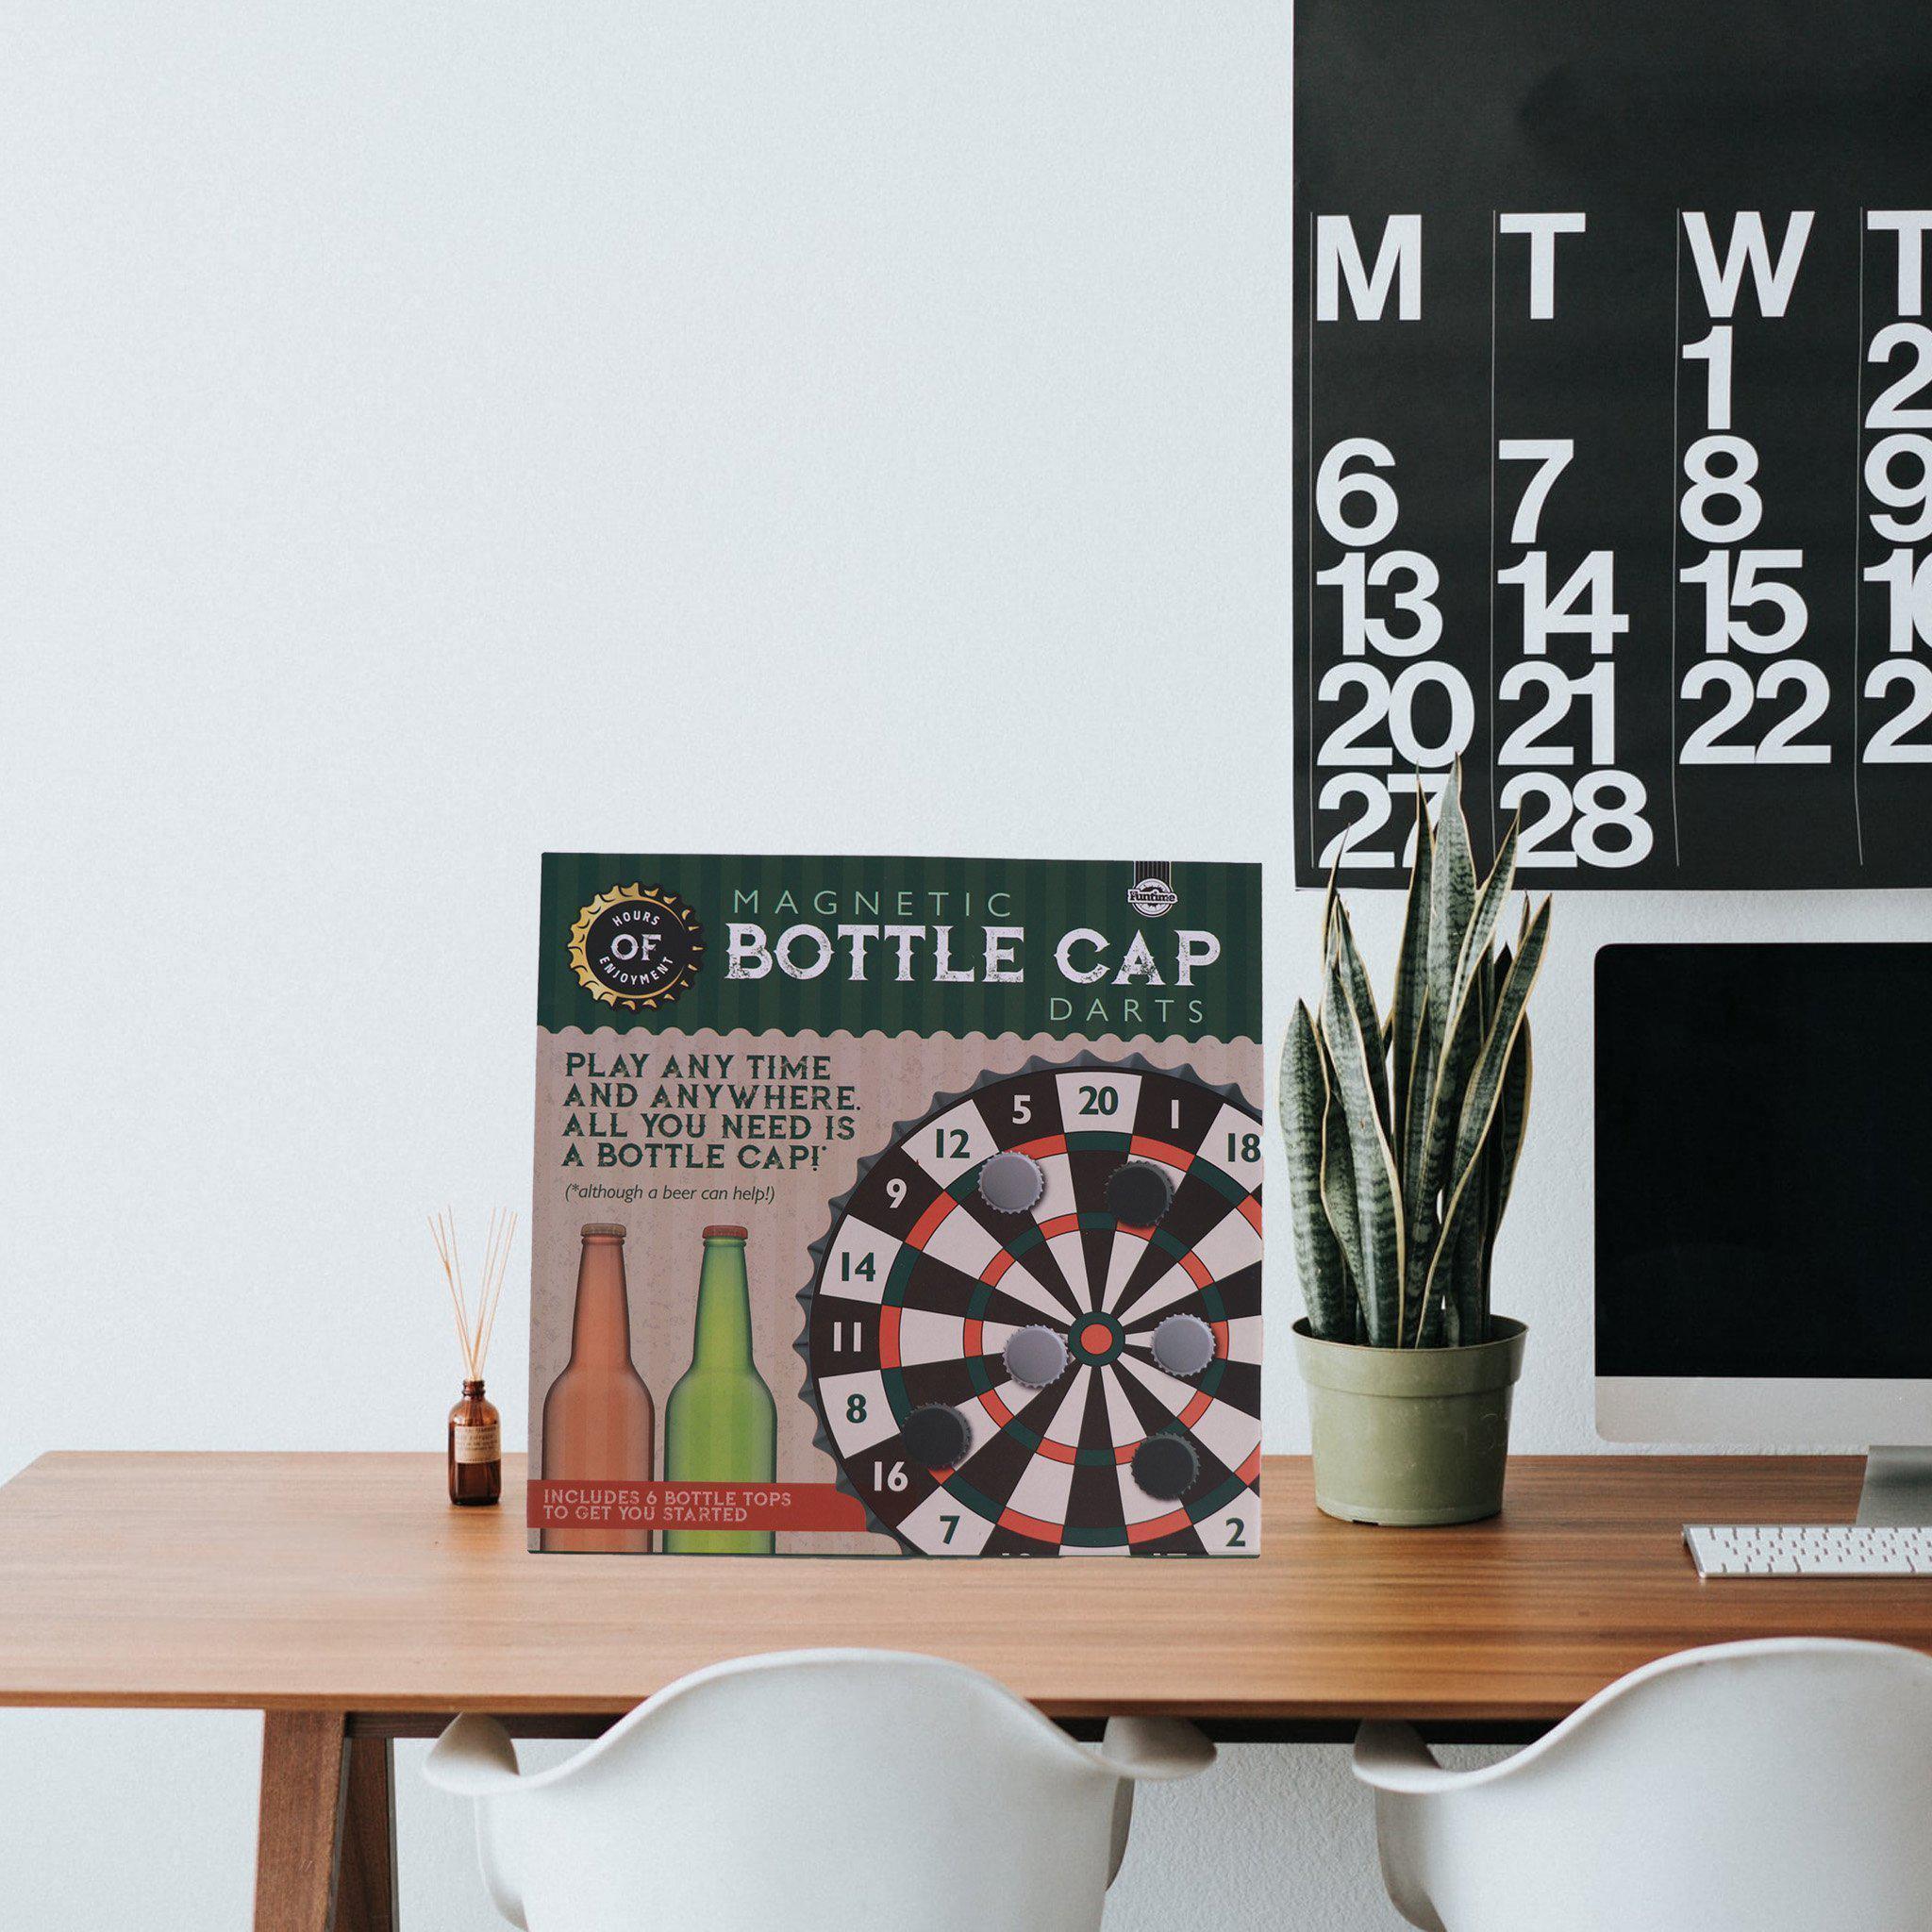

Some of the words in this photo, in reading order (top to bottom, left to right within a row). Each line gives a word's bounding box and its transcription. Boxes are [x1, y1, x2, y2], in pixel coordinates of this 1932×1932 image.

[1317, 214, 1422, 321] M
[1499, 213, 1587, 320] T
[1682, 210, 1816, 318] W
[1867, 210, 1932, 316] T
[1682, 325, 1733, 429] 1
[1864, 322, 1932, 428] 2
[1316, 438, 1399, 546] 6
[1499, 440, 1574, 543] 7
[1680, 434, 1763, 543] 8
[1864, 433, 1932, 542] 9
[1316, 550, 1443, 658] 13
[1497, 551, 1629, 655] 14
[1680, 549, 1808, 654] 15
[1863, 548, 1932, 653] 1
[1317, 660, 1474, 768] 20
[1497, 660, 1615, 766] 21
[1679, 659, 1832, 764] 22
[1318, 772, 1452, 868] 27
[1500, 770, 1653, 868] 28
[733, 889, 1011, 917] MAGNETIC
[1129, 890, 1176, 903] Funtime
[611, 910, 660, 926] HOURS
[610, 933, 661, 961] OF
[724, 923, 1024, 982] BOTTLE
[1054, 927, 1221, 987] CAP
[599, 956, 674, 986] ENJOYMENT
[1049, 997, 1203, 1024] DARTS
[566, 1052, 650, 1078] PLAY
[660, 1054, 734, 1079] ANY
[746, 1055, 831, 1080] TIME
[562, 1082, 638, 1108] AND
[650, 1084, 860, 1111] ANYWHERE.
[1011, 1094, 1031, 1125] 5
[1078, 1086, 1119, 1116] 20
[561, 1112, 627, 1138] ALL
[641, 1112, 708, 1139] YOU
[722, 1113, 811, 1140] NEED
[825, 1115, 856, 1141] IS
[1171, 1099, 1179, 1129] 1
[561, 1142, 584, 1167] A
[598, 1142, 724, 1169] BOTTLE
[936, 1128, 970, 1159] 12
[1227, 1133, 1261, 1163] 18
[648, 1188, 658, 1199] a
[662, 1185, 697, 1200] beer
[701, 1188, 728, 1200] can
[733, 1185, 775, 1205] help!)
[886, 1177, 908, 1208] 9
[841, 1251, 876, 1282] 14
[833, 1321, 862, 1352] 11
[845, 1393, 868, 1424] 8
[874, 1460, 908, 1492] 16
[543, 1489, 641, 1505] INCLUDES
[646, 1491, 658, 1506] 6
[664, 1491, 737, 1507] BOTTLE
[743, 1491, 791, 1507] TOPS
[543, 1505, 568, 1521] TO
[575, 1506, 611, 1521] GET
[620, 1506, 655, 1521] YOU
[662, 1507, 748, 1523] STARTED
[940, 1515, 960, 1544] 7
[1225, 1517, 1246, 1547] 2
